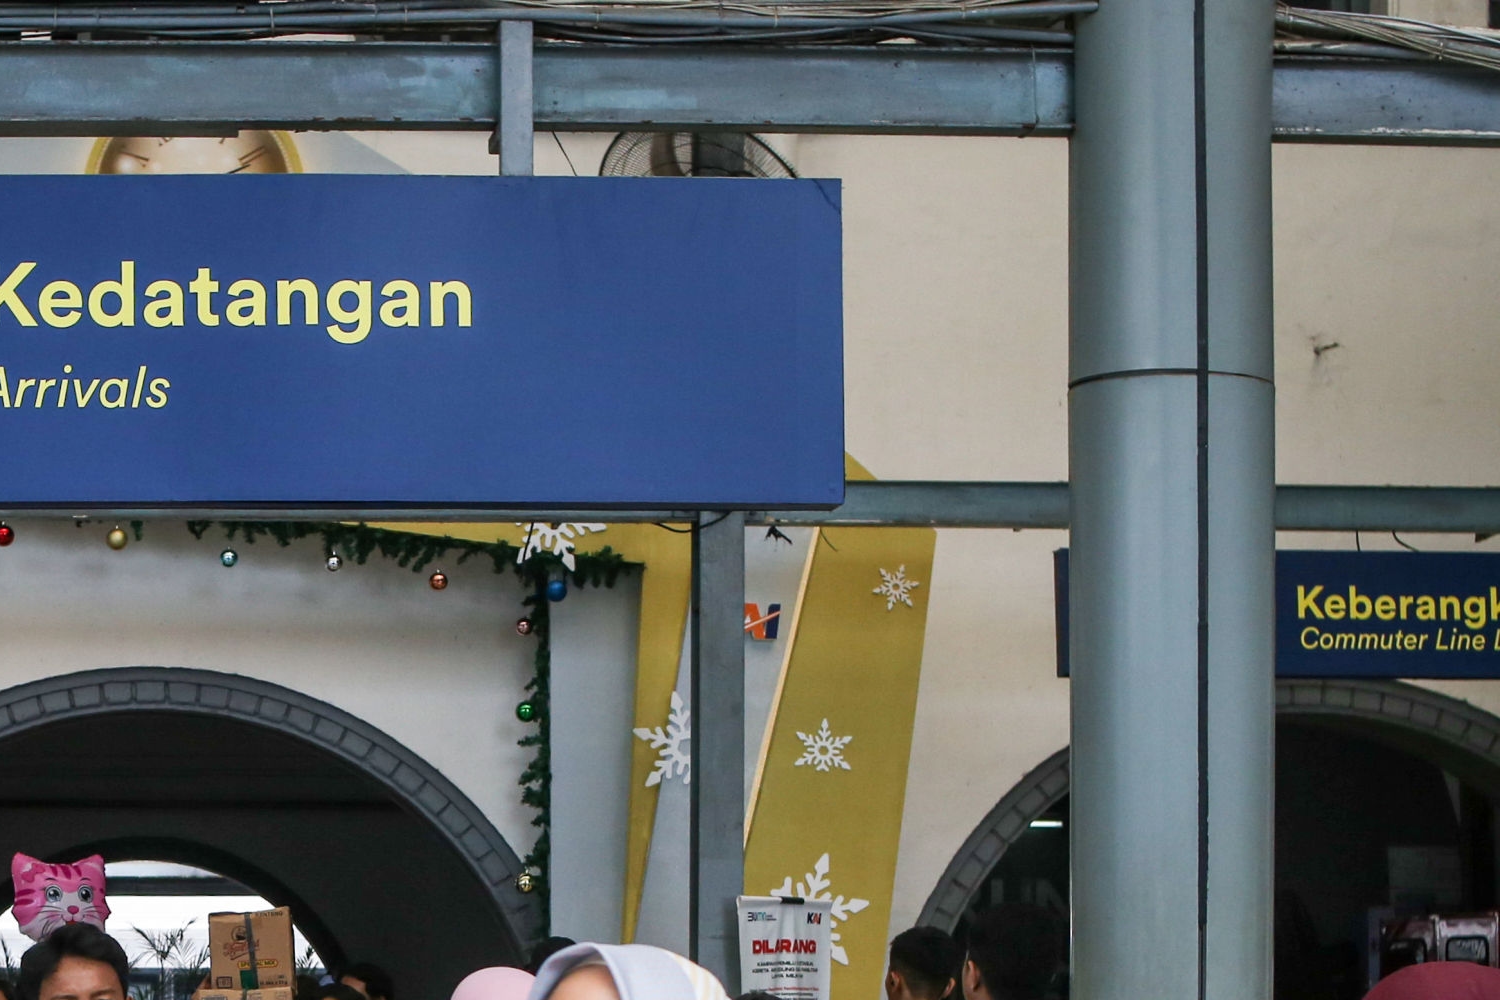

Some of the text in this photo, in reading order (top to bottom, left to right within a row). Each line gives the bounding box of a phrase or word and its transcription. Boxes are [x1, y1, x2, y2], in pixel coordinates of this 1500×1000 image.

[744, 602, 781, 640] AI
[1300, 626, 1428, 650] Commuter
[1435, 627, 1486, 651] Line
[752, 938, 817, 955] DILARANG
